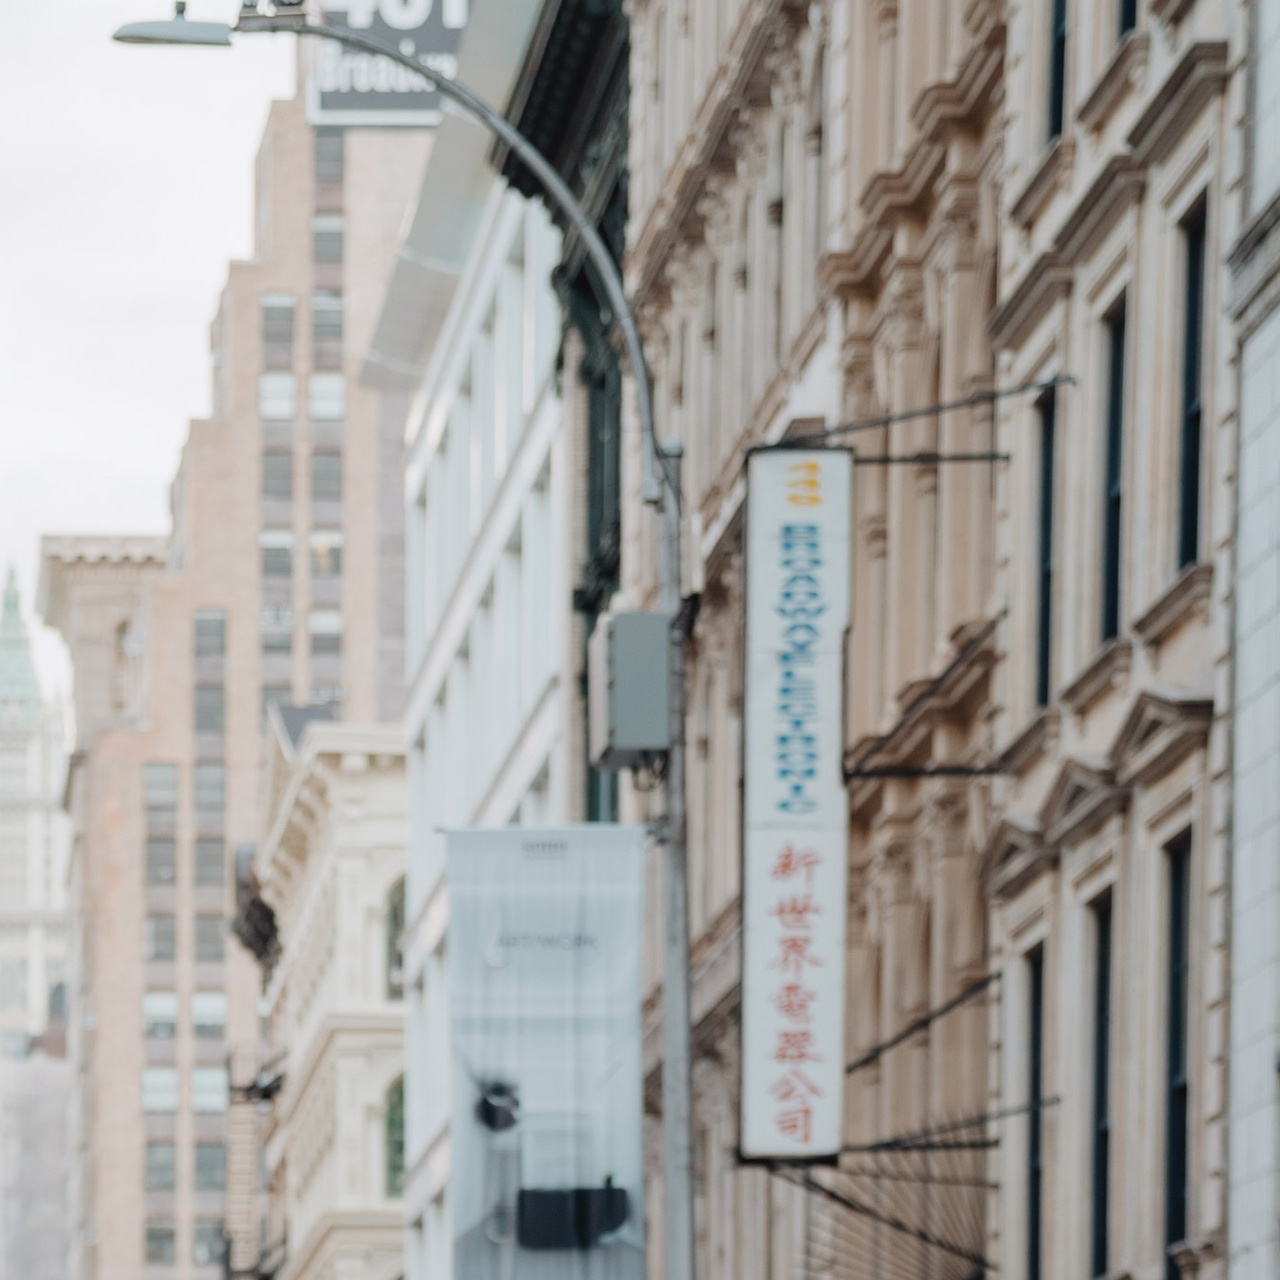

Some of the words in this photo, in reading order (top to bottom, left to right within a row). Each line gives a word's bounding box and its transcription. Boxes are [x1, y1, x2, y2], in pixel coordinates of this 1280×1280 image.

[775, 523, 827, 650] BROADWAY
[776, 650, 819, 814] ELECTRONIC
[768, 841, 823, 1145] 新世界電器公司
